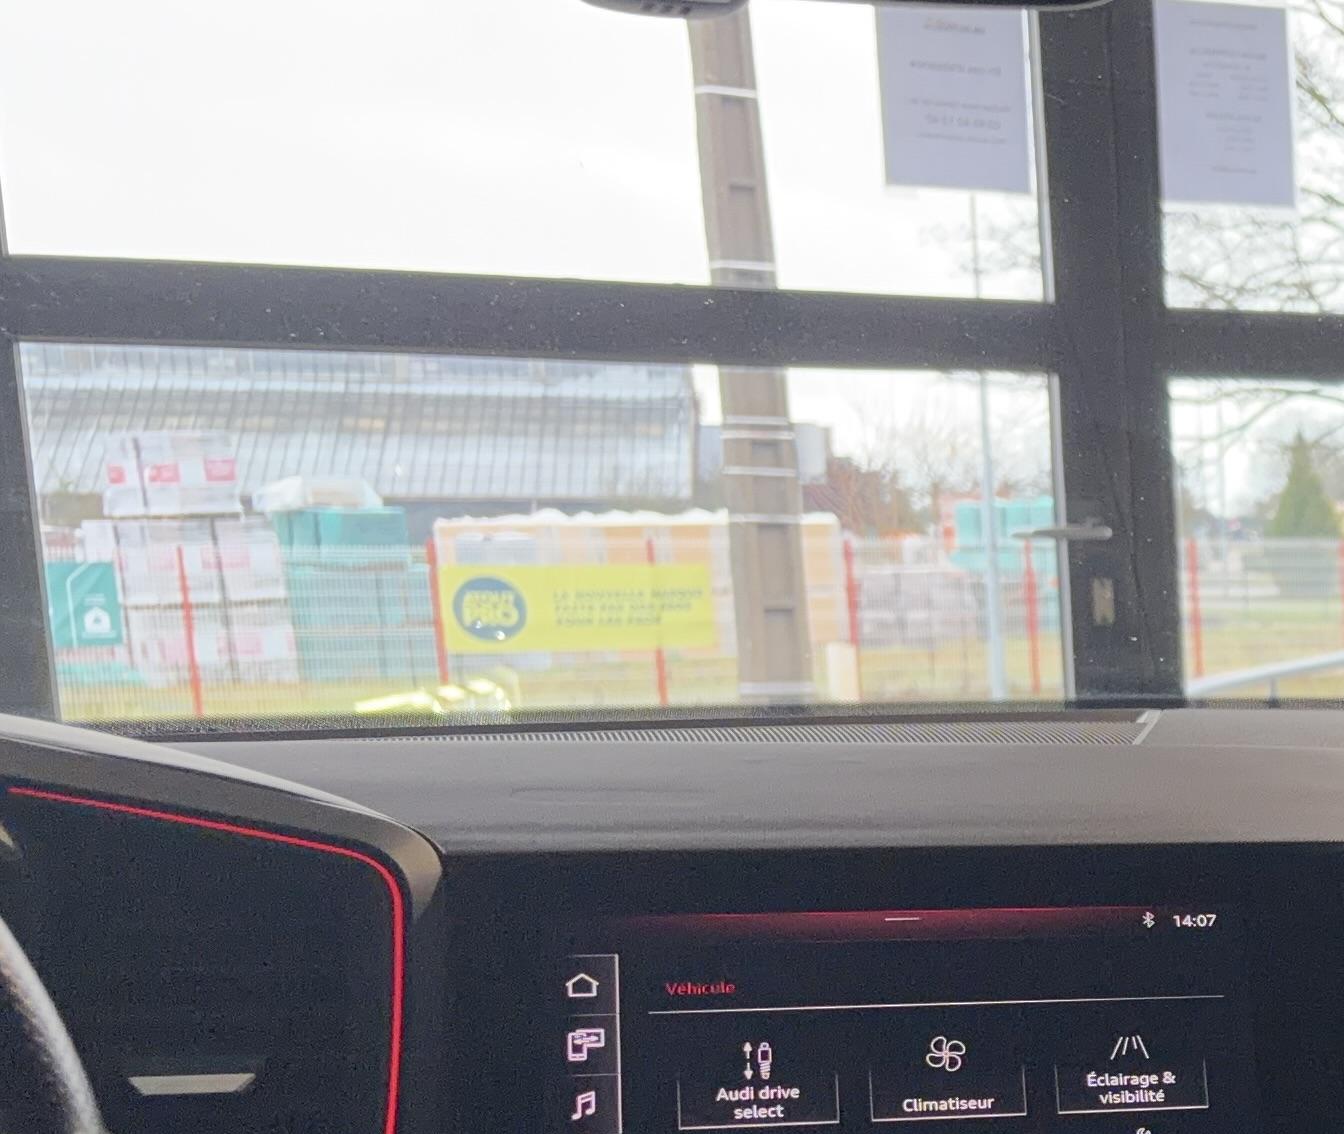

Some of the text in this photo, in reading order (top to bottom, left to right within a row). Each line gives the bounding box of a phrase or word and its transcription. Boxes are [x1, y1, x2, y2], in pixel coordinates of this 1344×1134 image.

[1173, 914, 1217, 928] 14:07
[665, 980, 736, 996] Véhicule
[1086, 1070, 1177, 1090] Éclairage &
[716, 1084, 801, 1102] Audi drive
[1098, 1088, 1166, 1105] visibilité
[733, 1104, 785, 1120] select
[902, 1094, 995, 1113] Climatiseur
